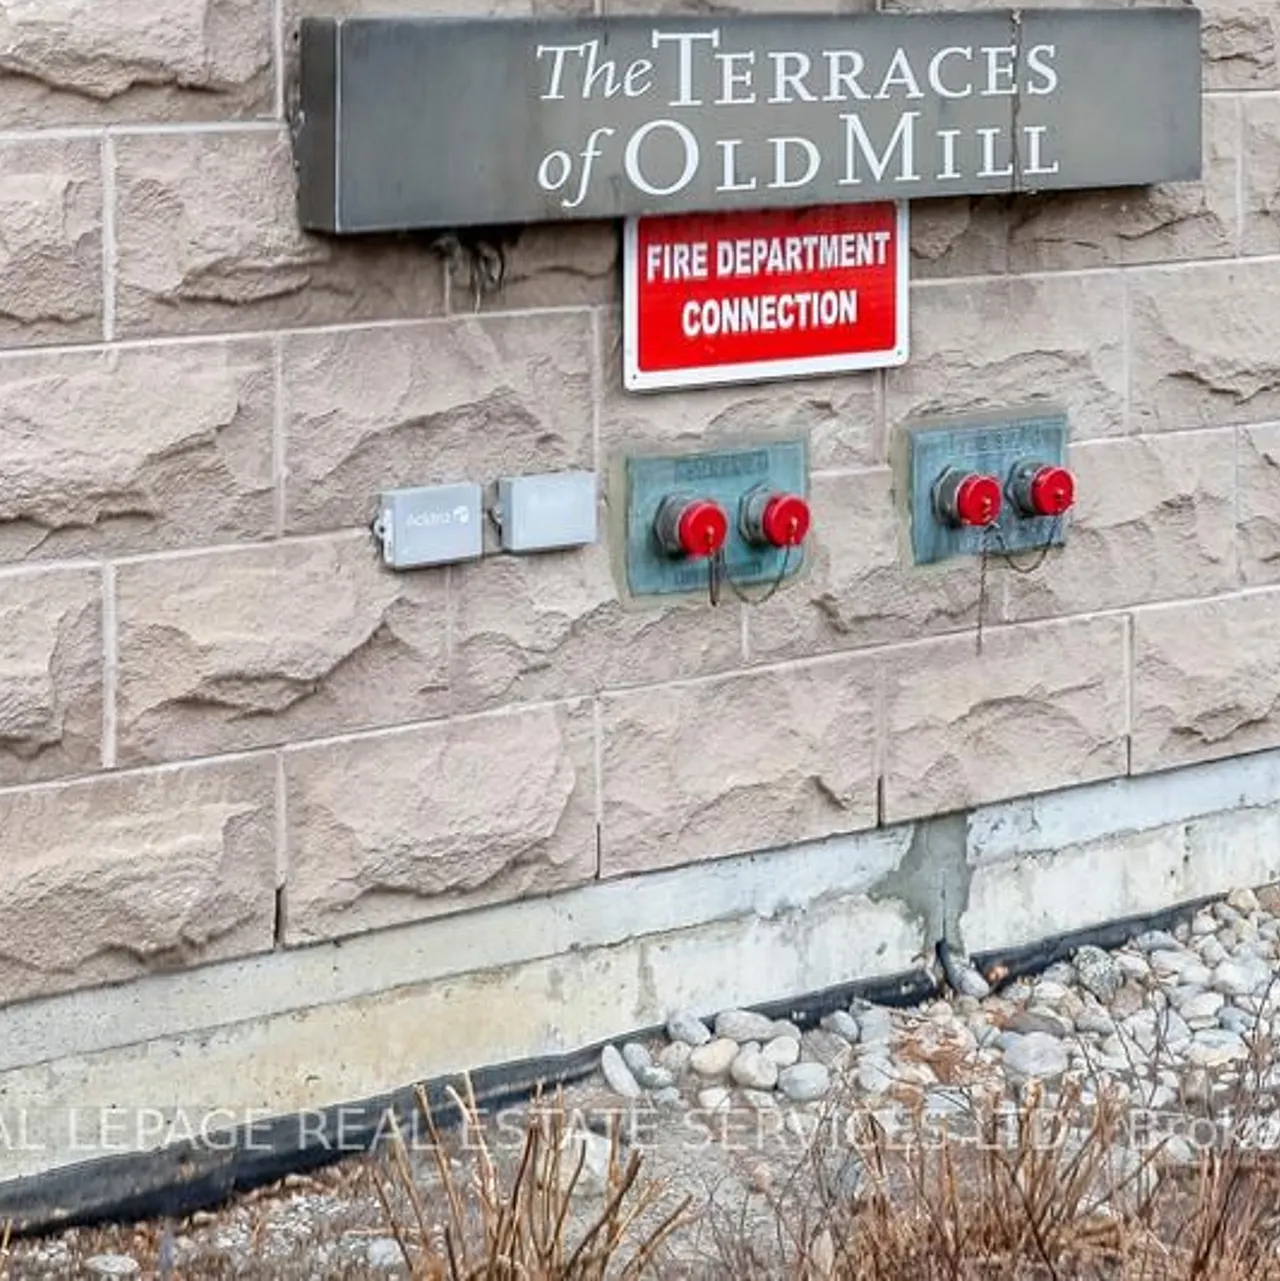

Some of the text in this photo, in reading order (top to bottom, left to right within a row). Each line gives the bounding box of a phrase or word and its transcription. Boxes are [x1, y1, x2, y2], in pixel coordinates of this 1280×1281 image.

[536, 29, 1059, 107] The TERRACES
[537, 110, 1059, 207] of OLD MILL
[646, 231, 891, 283] FIRE DEPARTMENT
[682, 288, 858, 338] CONNECTION
